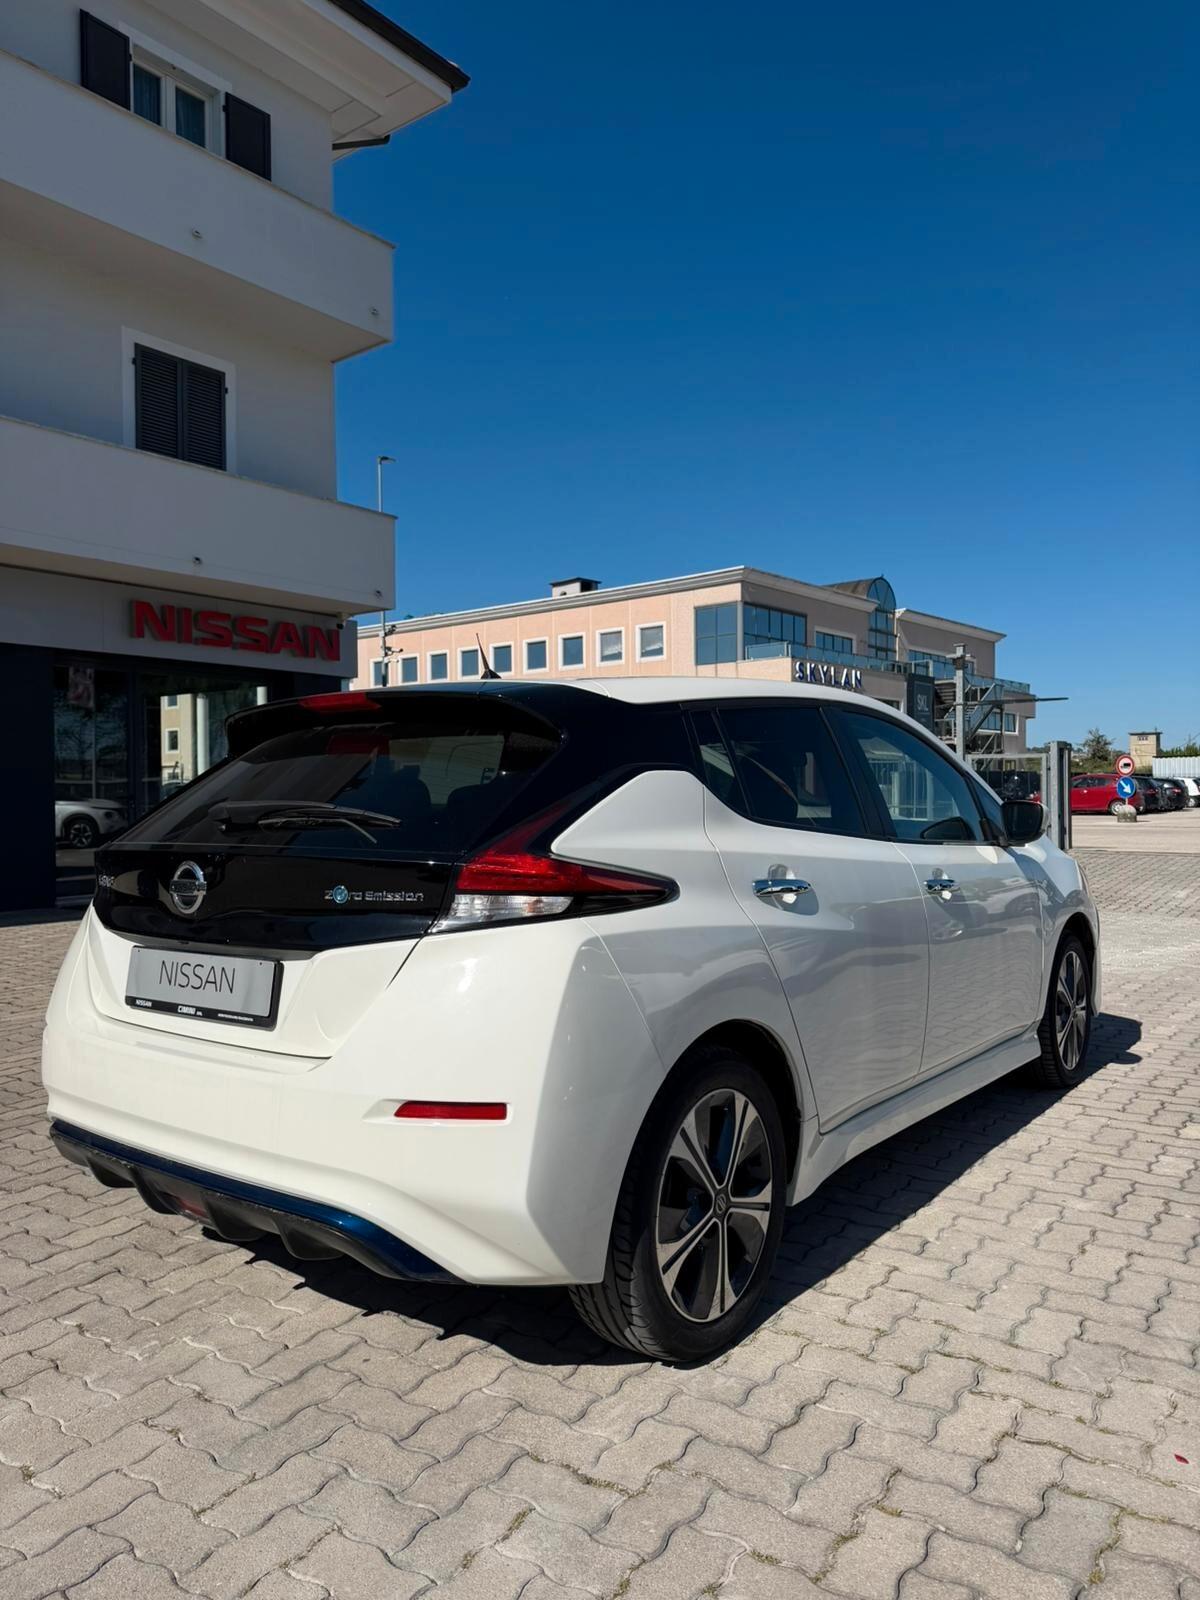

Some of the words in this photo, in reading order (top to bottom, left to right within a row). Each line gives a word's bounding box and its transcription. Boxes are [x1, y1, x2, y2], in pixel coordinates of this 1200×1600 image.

[131, 600, 341, 662] NISSAN
[795, 661, 862, 689] SKYLAN
[158, 959, 236, 994] NISSAN
